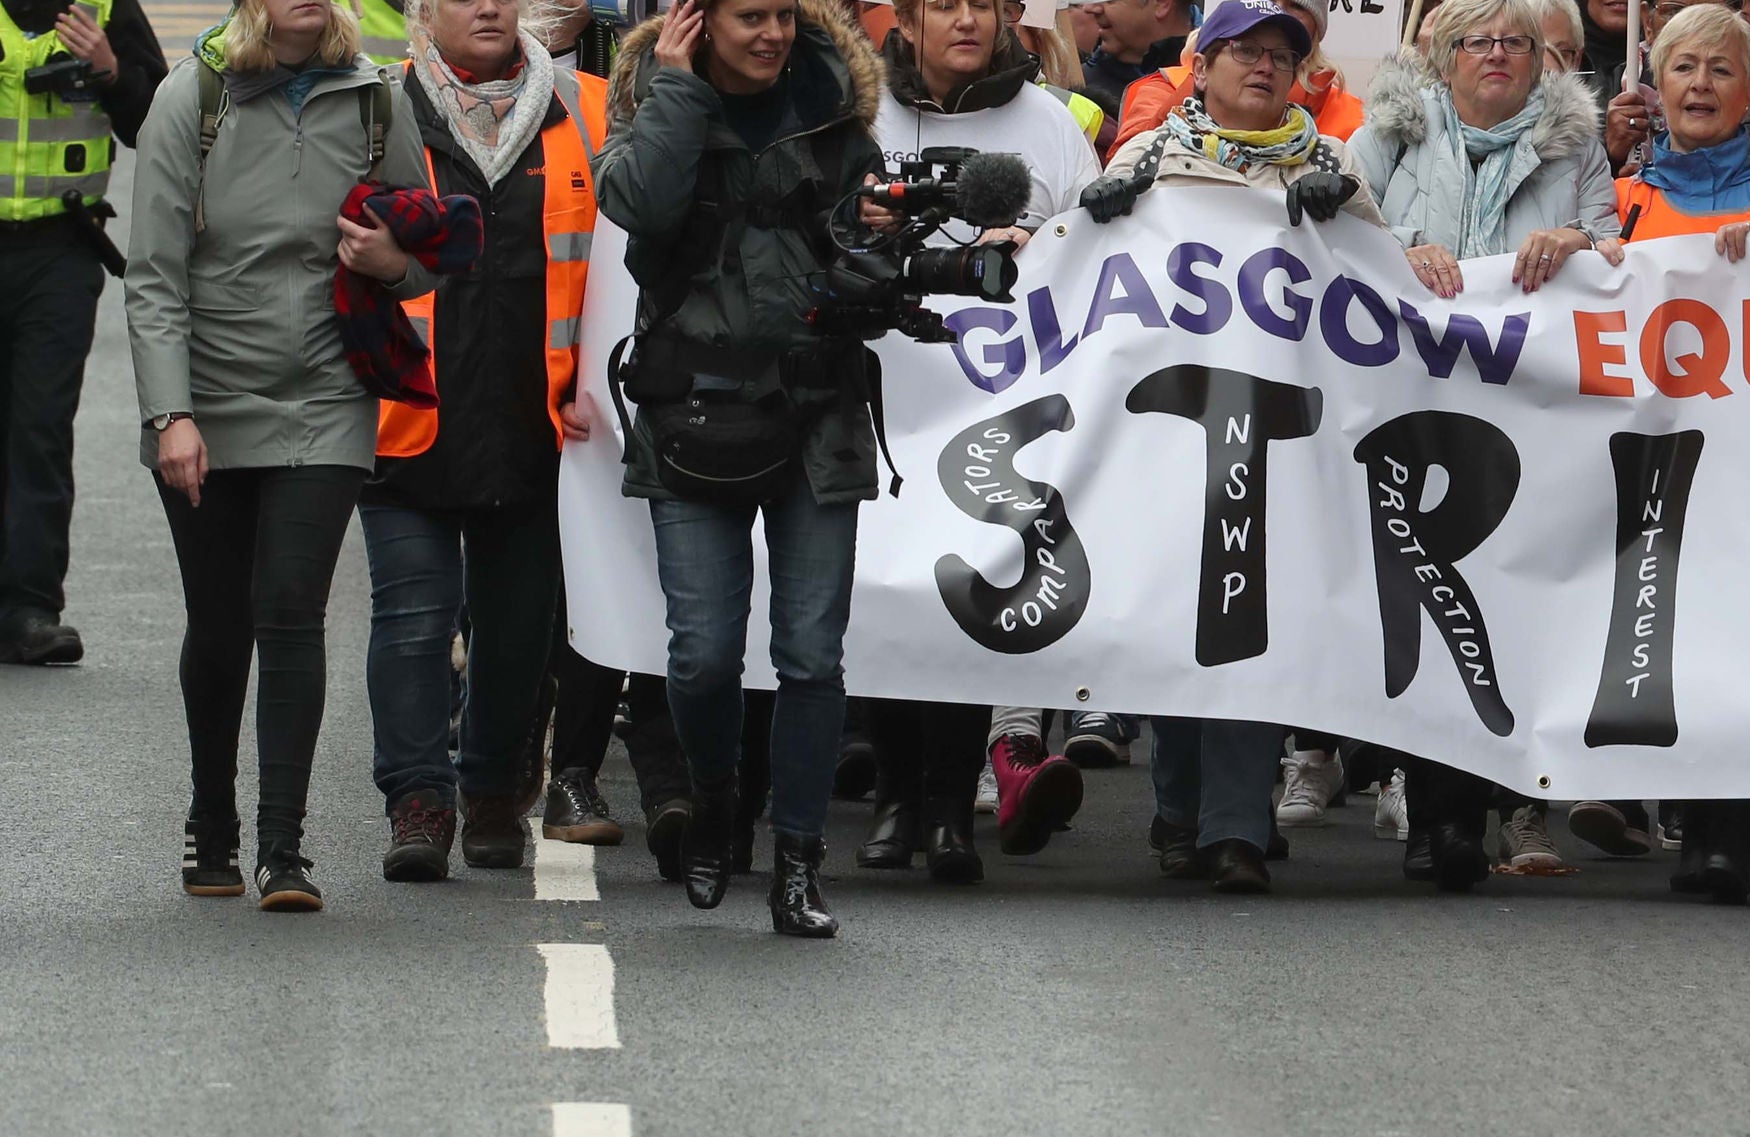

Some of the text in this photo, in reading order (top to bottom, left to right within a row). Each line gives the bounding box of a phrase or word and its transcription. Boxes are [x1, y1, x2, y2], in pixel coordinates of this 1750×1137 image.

[943, 241, 1532, 395] GLASGOW
[1379, 455, 1492, 687] PROTECTION
[1624, 467, 1663, 700] INTEREST
